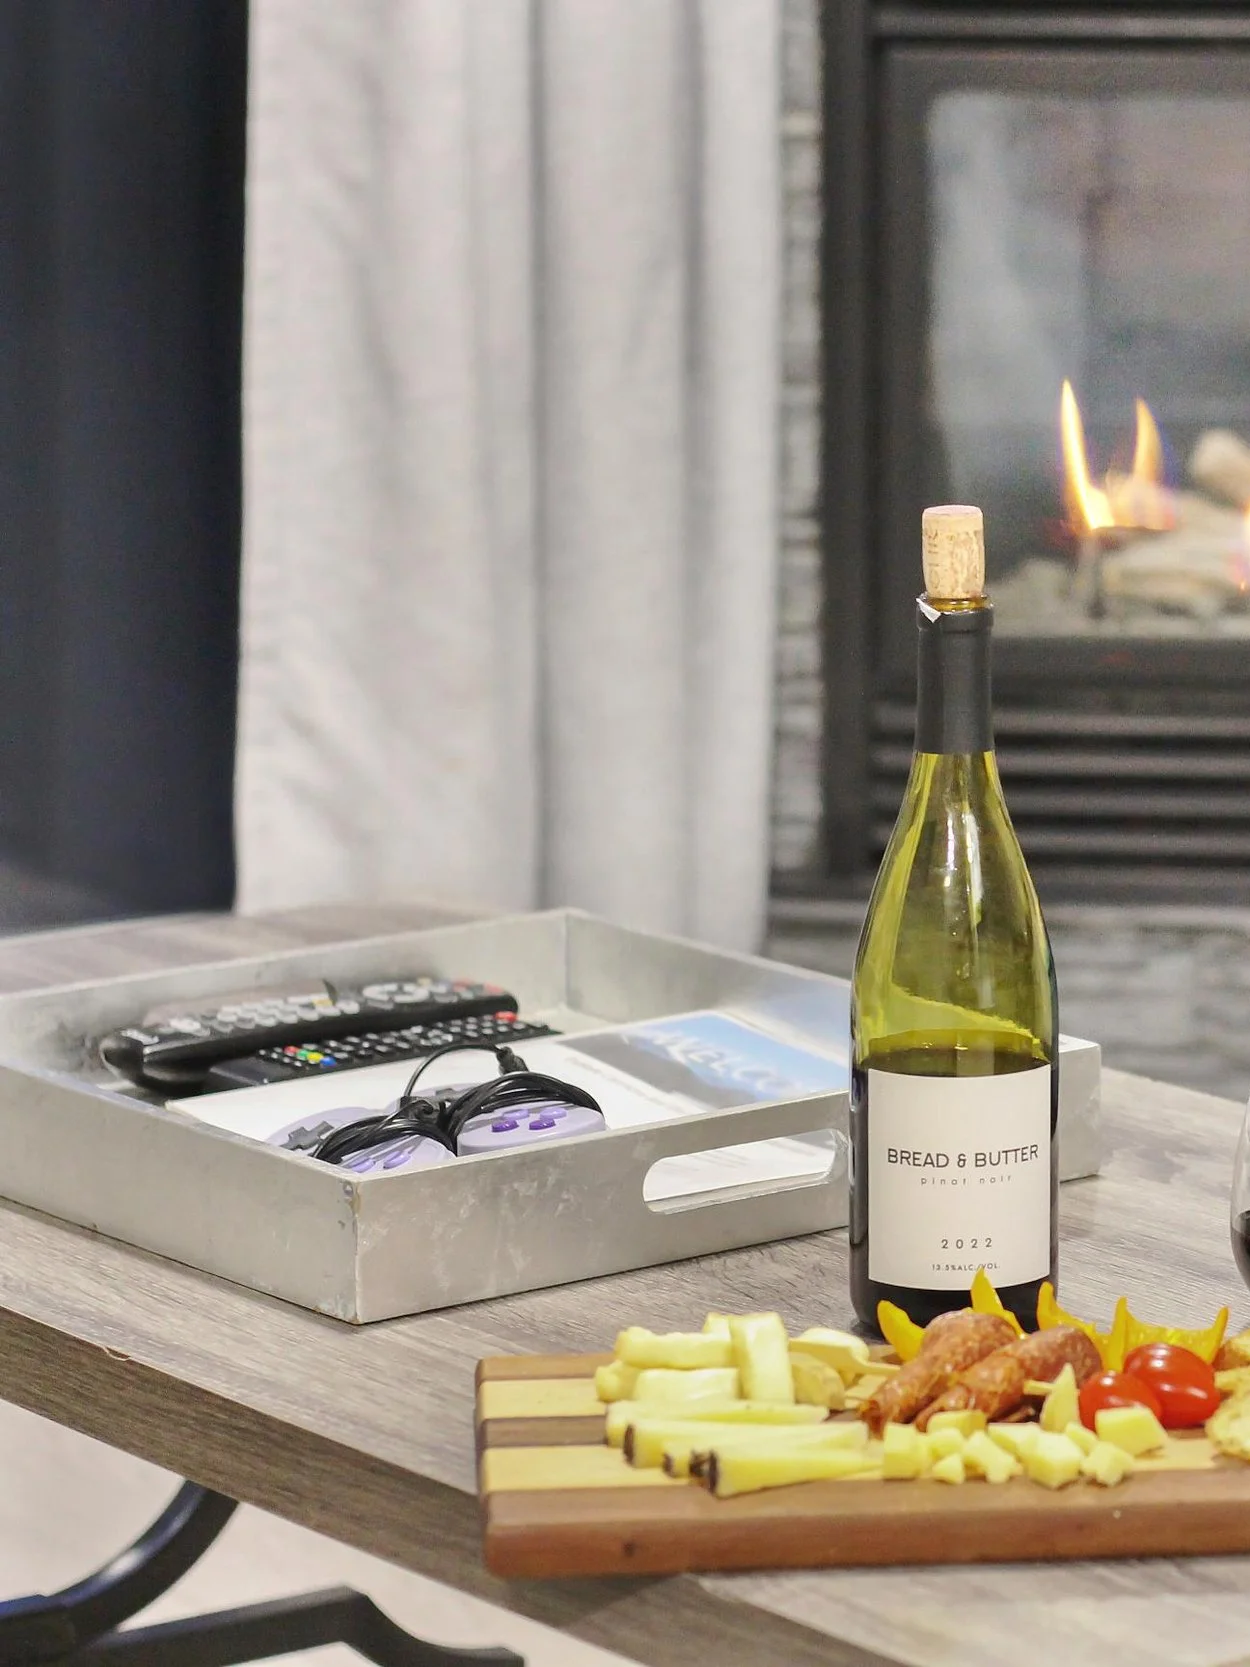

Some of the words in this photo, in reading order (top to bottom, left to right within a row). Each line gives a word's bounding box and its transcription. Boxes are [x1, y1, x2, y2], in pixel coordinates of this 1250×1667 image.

[887, 1148, 949, 1169] BREAD
[956, 1153, 967, 1169] &
[974, 1144, 1039, 1168] BUTTER
[920, 1175, 968, 1186] pinot
[979, 1174, 1013, 1185] noir
[941, 1237, 993, 1250] 2022
